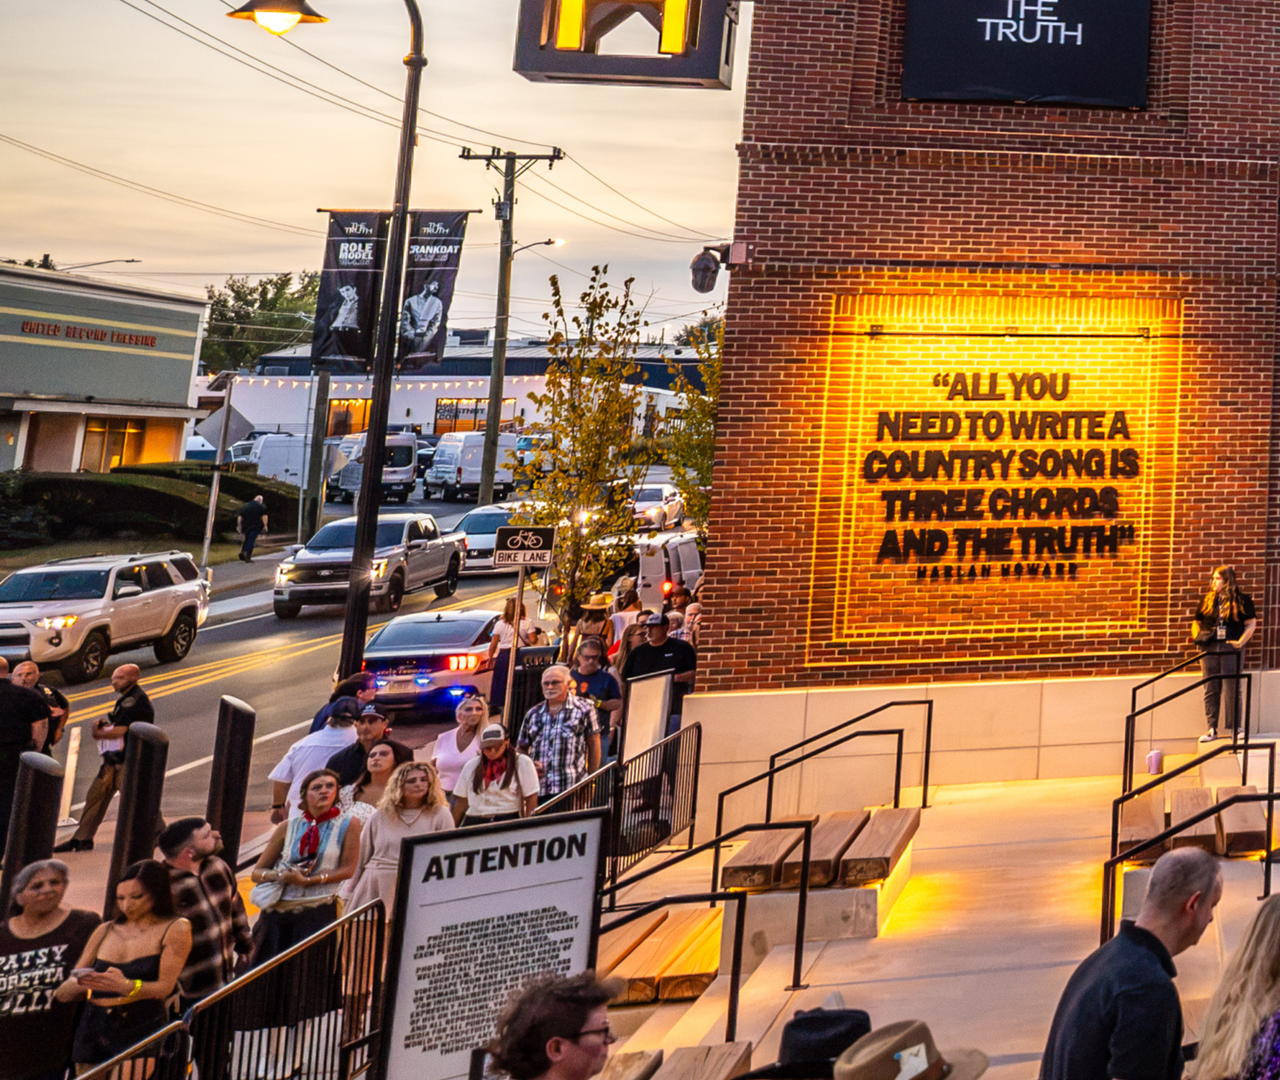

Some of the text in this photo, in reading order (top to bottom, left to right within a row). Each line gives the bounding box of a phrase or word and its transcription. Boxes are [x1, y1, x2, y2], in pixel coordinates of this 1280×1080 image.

[976, 18, 1082, 46] TRUTH
[344, 226, 373, 234] TRUTH
[349, 221, 367, 230] THE
[422, 226, 450, 234] TRUTH
[427, 221, 444, 230] THE
[338, 251, 374, 260] MODEL
[340, 242, 374, 252] ROLE
[21, 320, 61, 336] UNITED
[1008, 372, 1070, 401] YOU
[876, 410, 1131, 442] NEED TO WRITE A
[863, 448, 1140, 483] COUNTRY SONG IS
[881, 486, 1120, 522] THREE CHORDS
[876, 528, 949, 564] AND
[952, 527, 1014, 560] THE
[497, 551, 549, 563] BIKE LANE
[916, 561, 1079, 581] HARLAN HOWARD
[421, 832, 588, 884] ATTENTION
